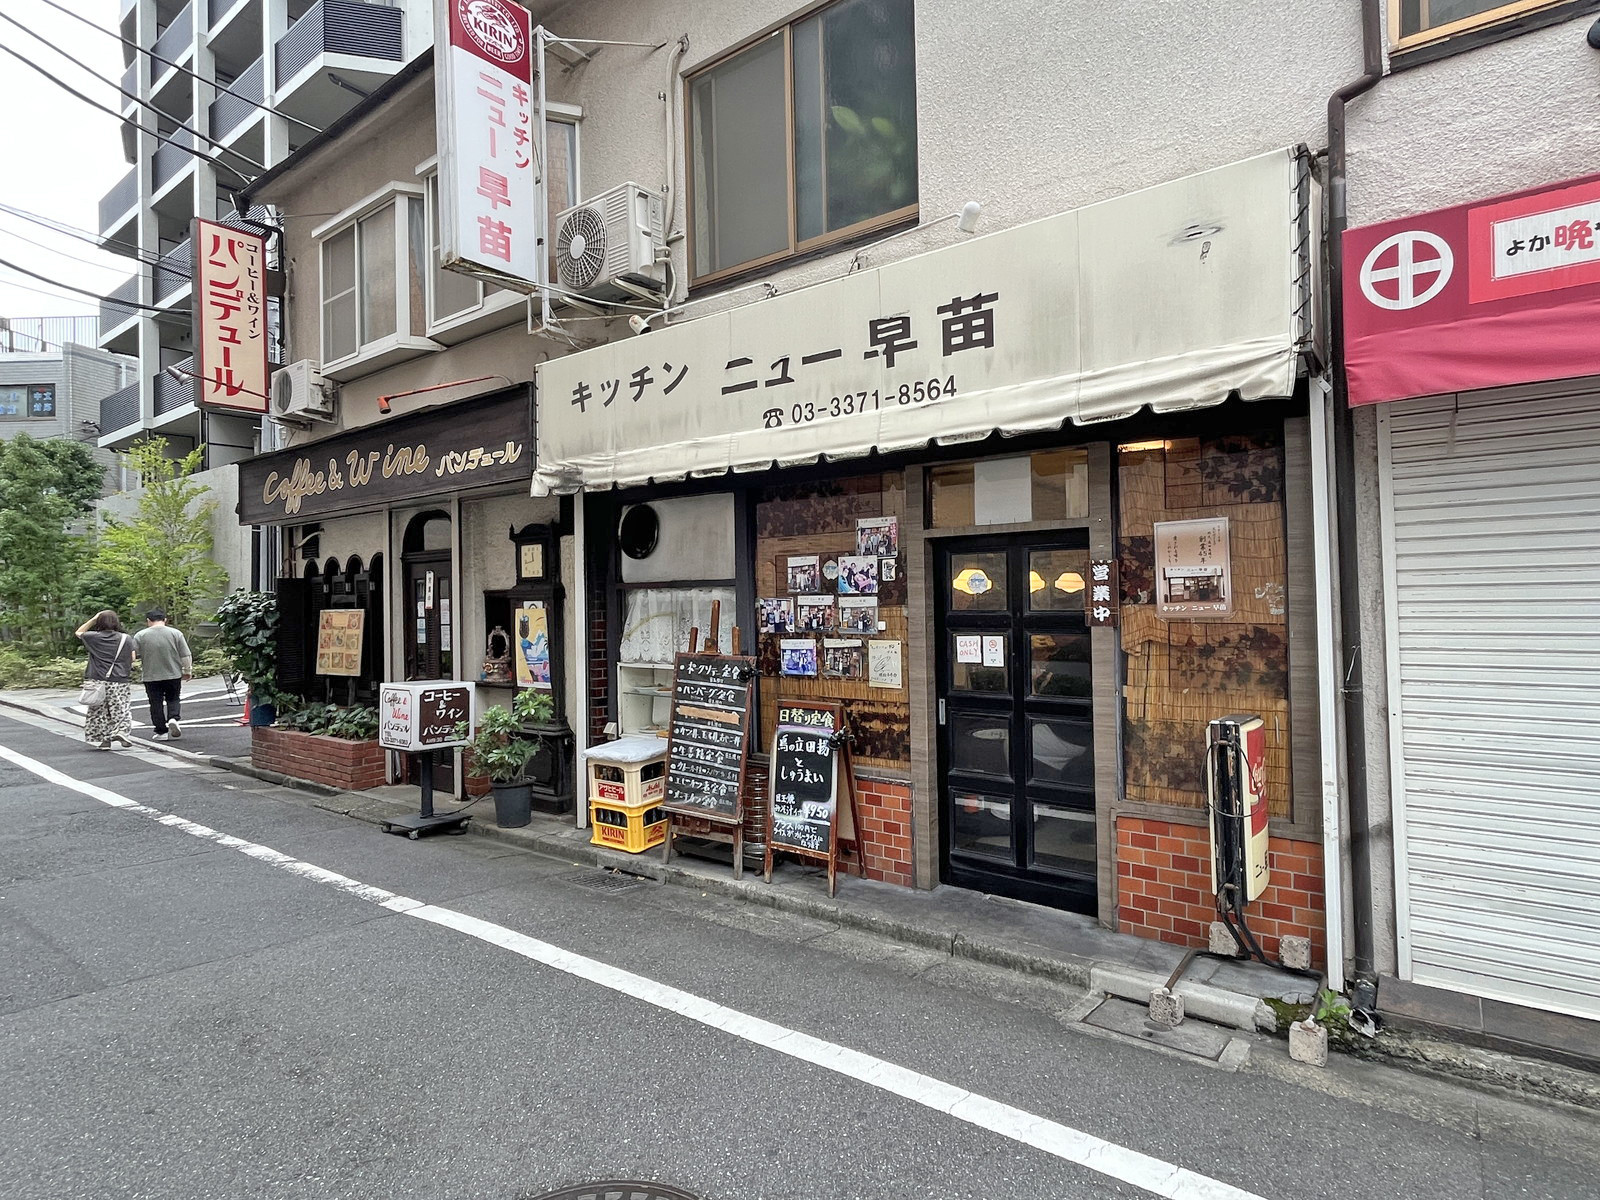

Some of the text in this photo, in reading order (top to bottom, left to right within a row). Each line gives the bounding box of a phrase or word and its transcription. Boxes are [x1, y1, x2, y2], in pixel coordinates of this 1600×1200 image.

[474, 16, 513, 48] KIRIN
[513, 83, 530, 169] キッチン
[1505, 218, 1600, 257] よか晩
[245, 243, 261, 340] コーヒー&ワイン
[571, 360, 690, 413] キッチン
[791, 374, 958, 424] 03-3371-8564
[263, 457, 327, 515] Coffee
[327, 457, 344, 491] &
[435, 440, 523, 478] パンデュール
[1092, 564, 1111, 622] 営業中
[958, 640, 979, 648] CASH
[959, 647, 979, 657] ONLY
[424, 690, 461, 703] コーヒー
[436, 708, 464, 720] ワイン
[779, 708, 835, 729] 日替り定食
[794, 757, 804, 768] と
[780, 765, 825, 784] しゅうまい
[803, 803, 829, 820] ¥950
[601, 826, 625, 840] KIRIN
